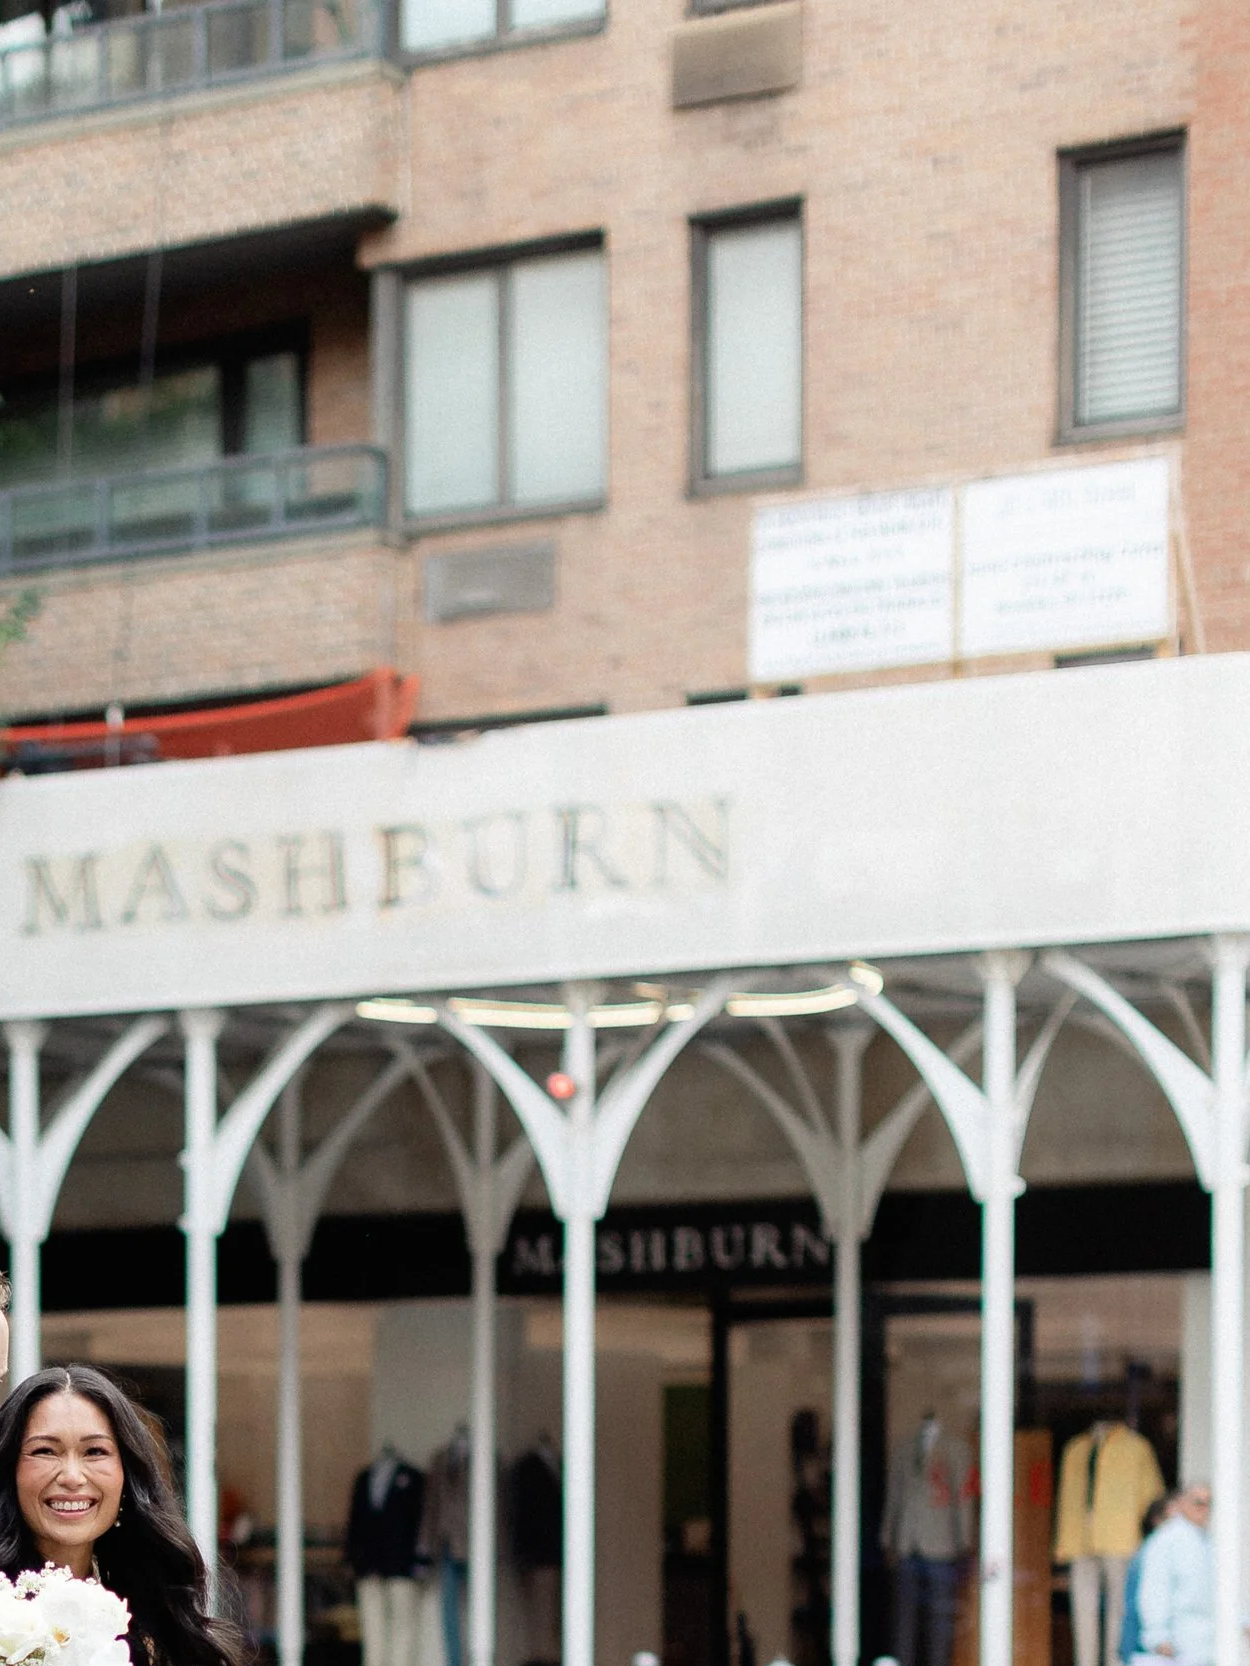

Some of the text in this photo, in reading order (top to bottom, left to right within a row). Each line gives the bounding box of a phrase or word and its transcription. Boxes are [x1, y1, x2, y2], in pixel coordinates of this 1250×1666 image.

[18, 790, 735, 938] MASHBURN
[512, 1221, 831, 1276] MSHBURN
[928, 1460, 1054, 1509] SAE
